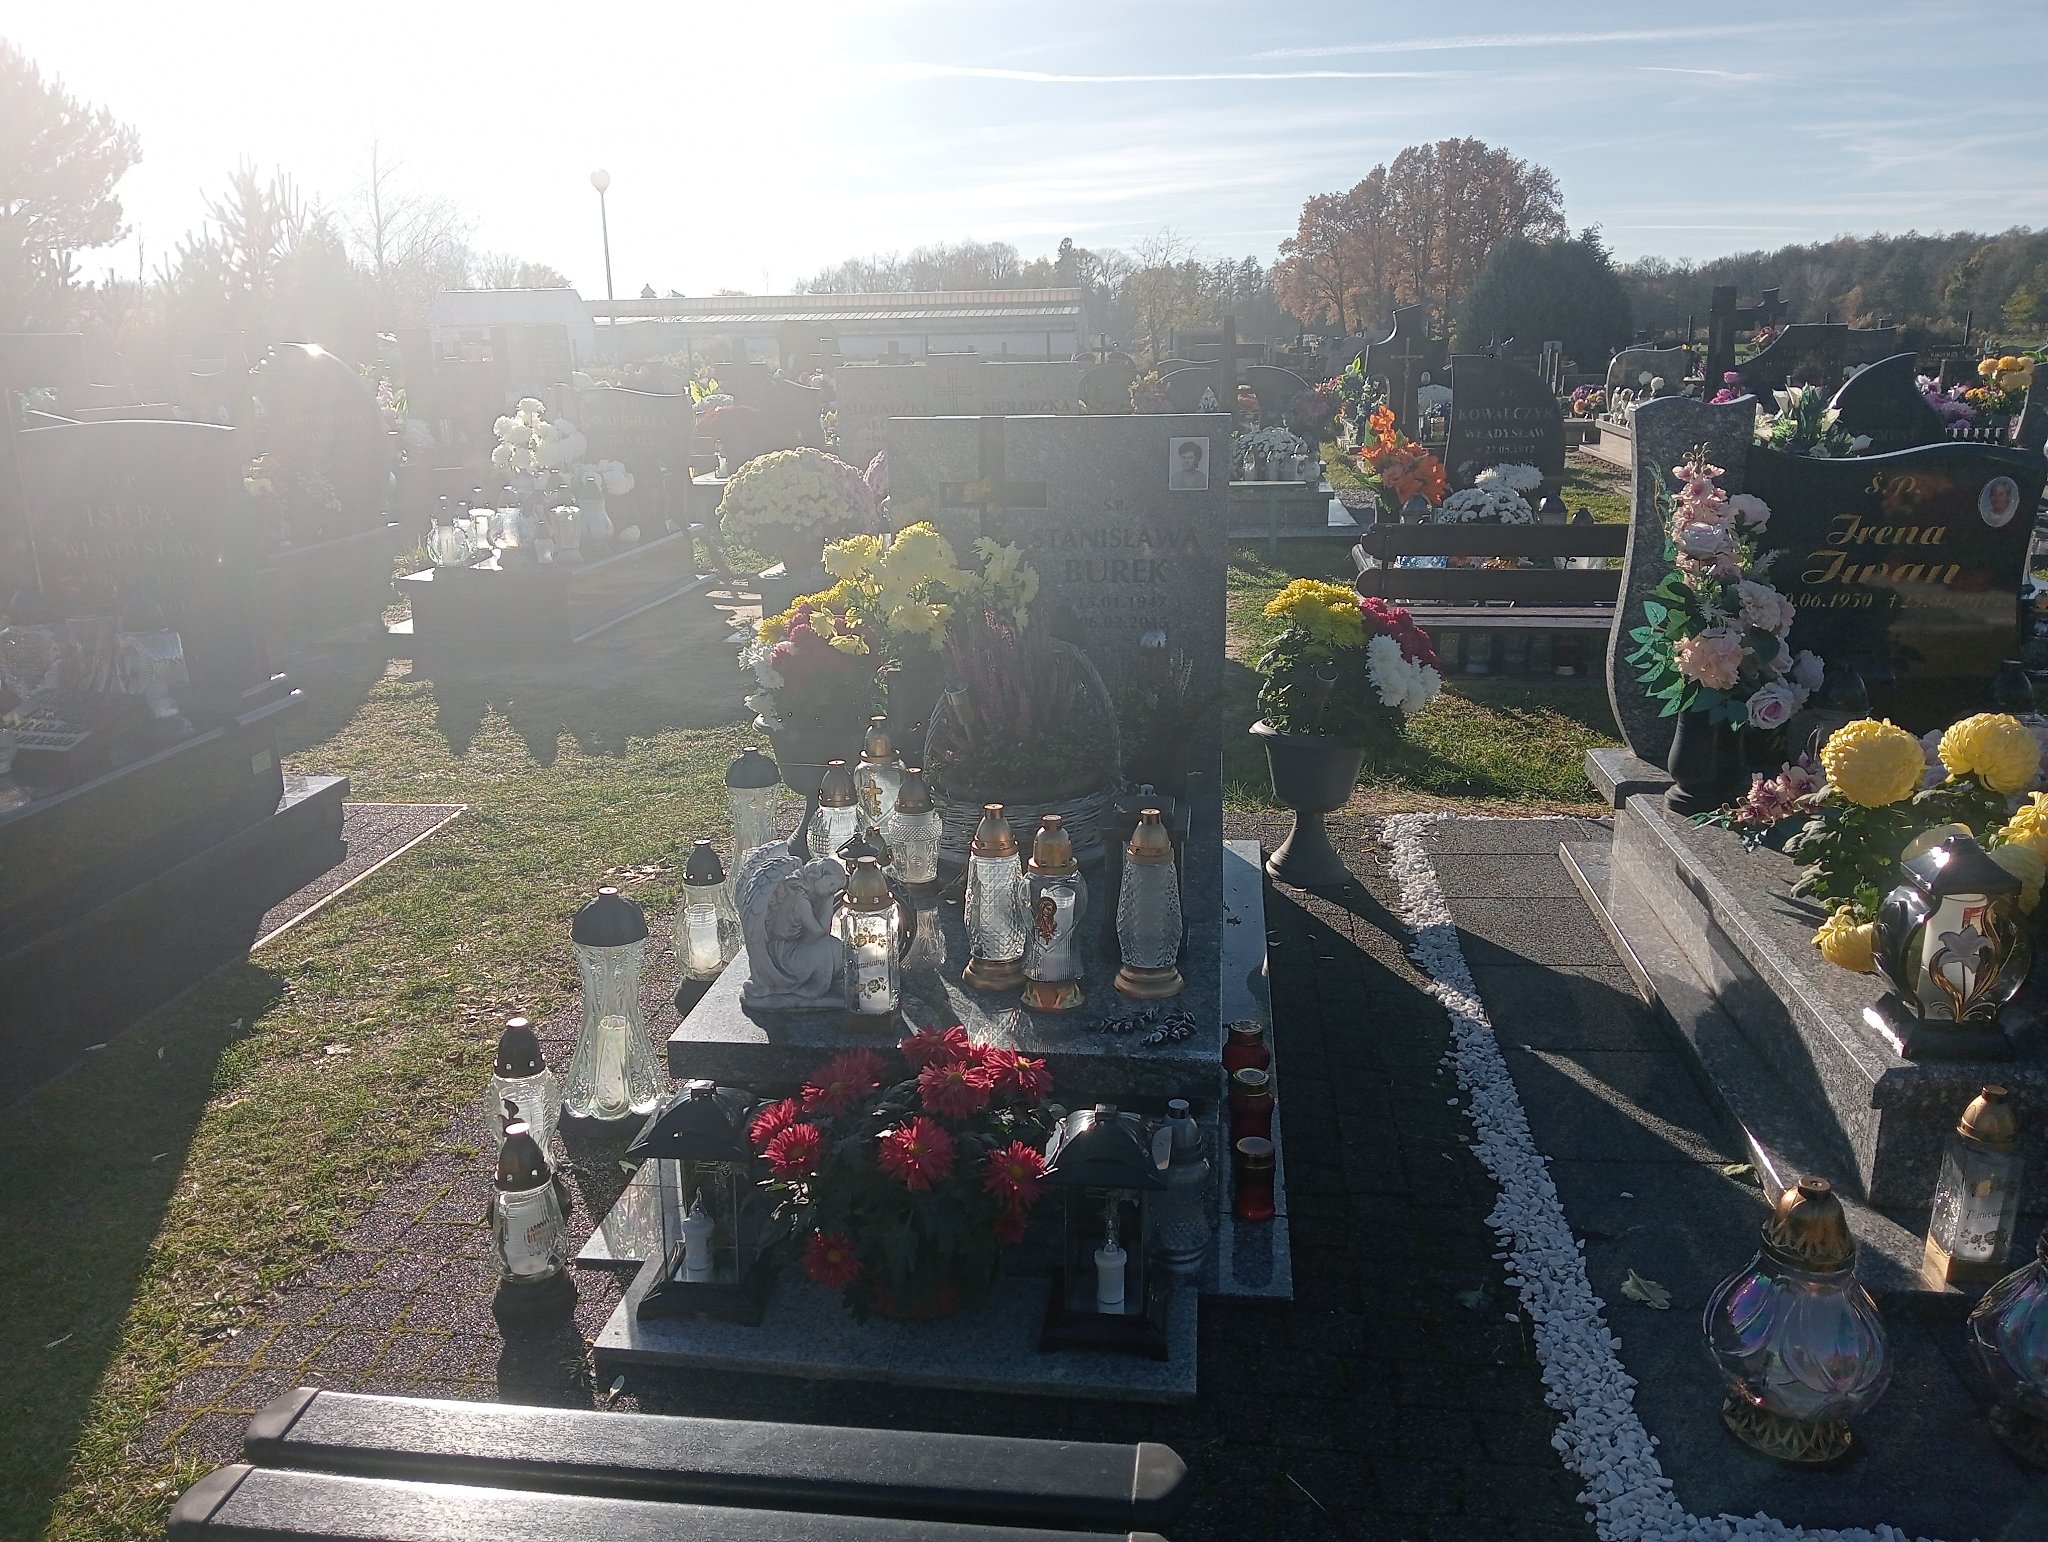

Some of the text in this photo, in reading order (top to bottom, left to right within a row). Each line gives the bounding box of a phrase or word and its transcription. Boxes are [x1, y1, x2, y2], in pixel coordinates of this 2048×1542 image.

[85, 504, 176, 528] ISKRA
[1032, 527, 1202, 548] STANISŁAWA
[1827, 513, 1947, 546] Irena
[1064, 558, 1170, 584] BUREK
[1801, 549, 1961, 585] Iwan
